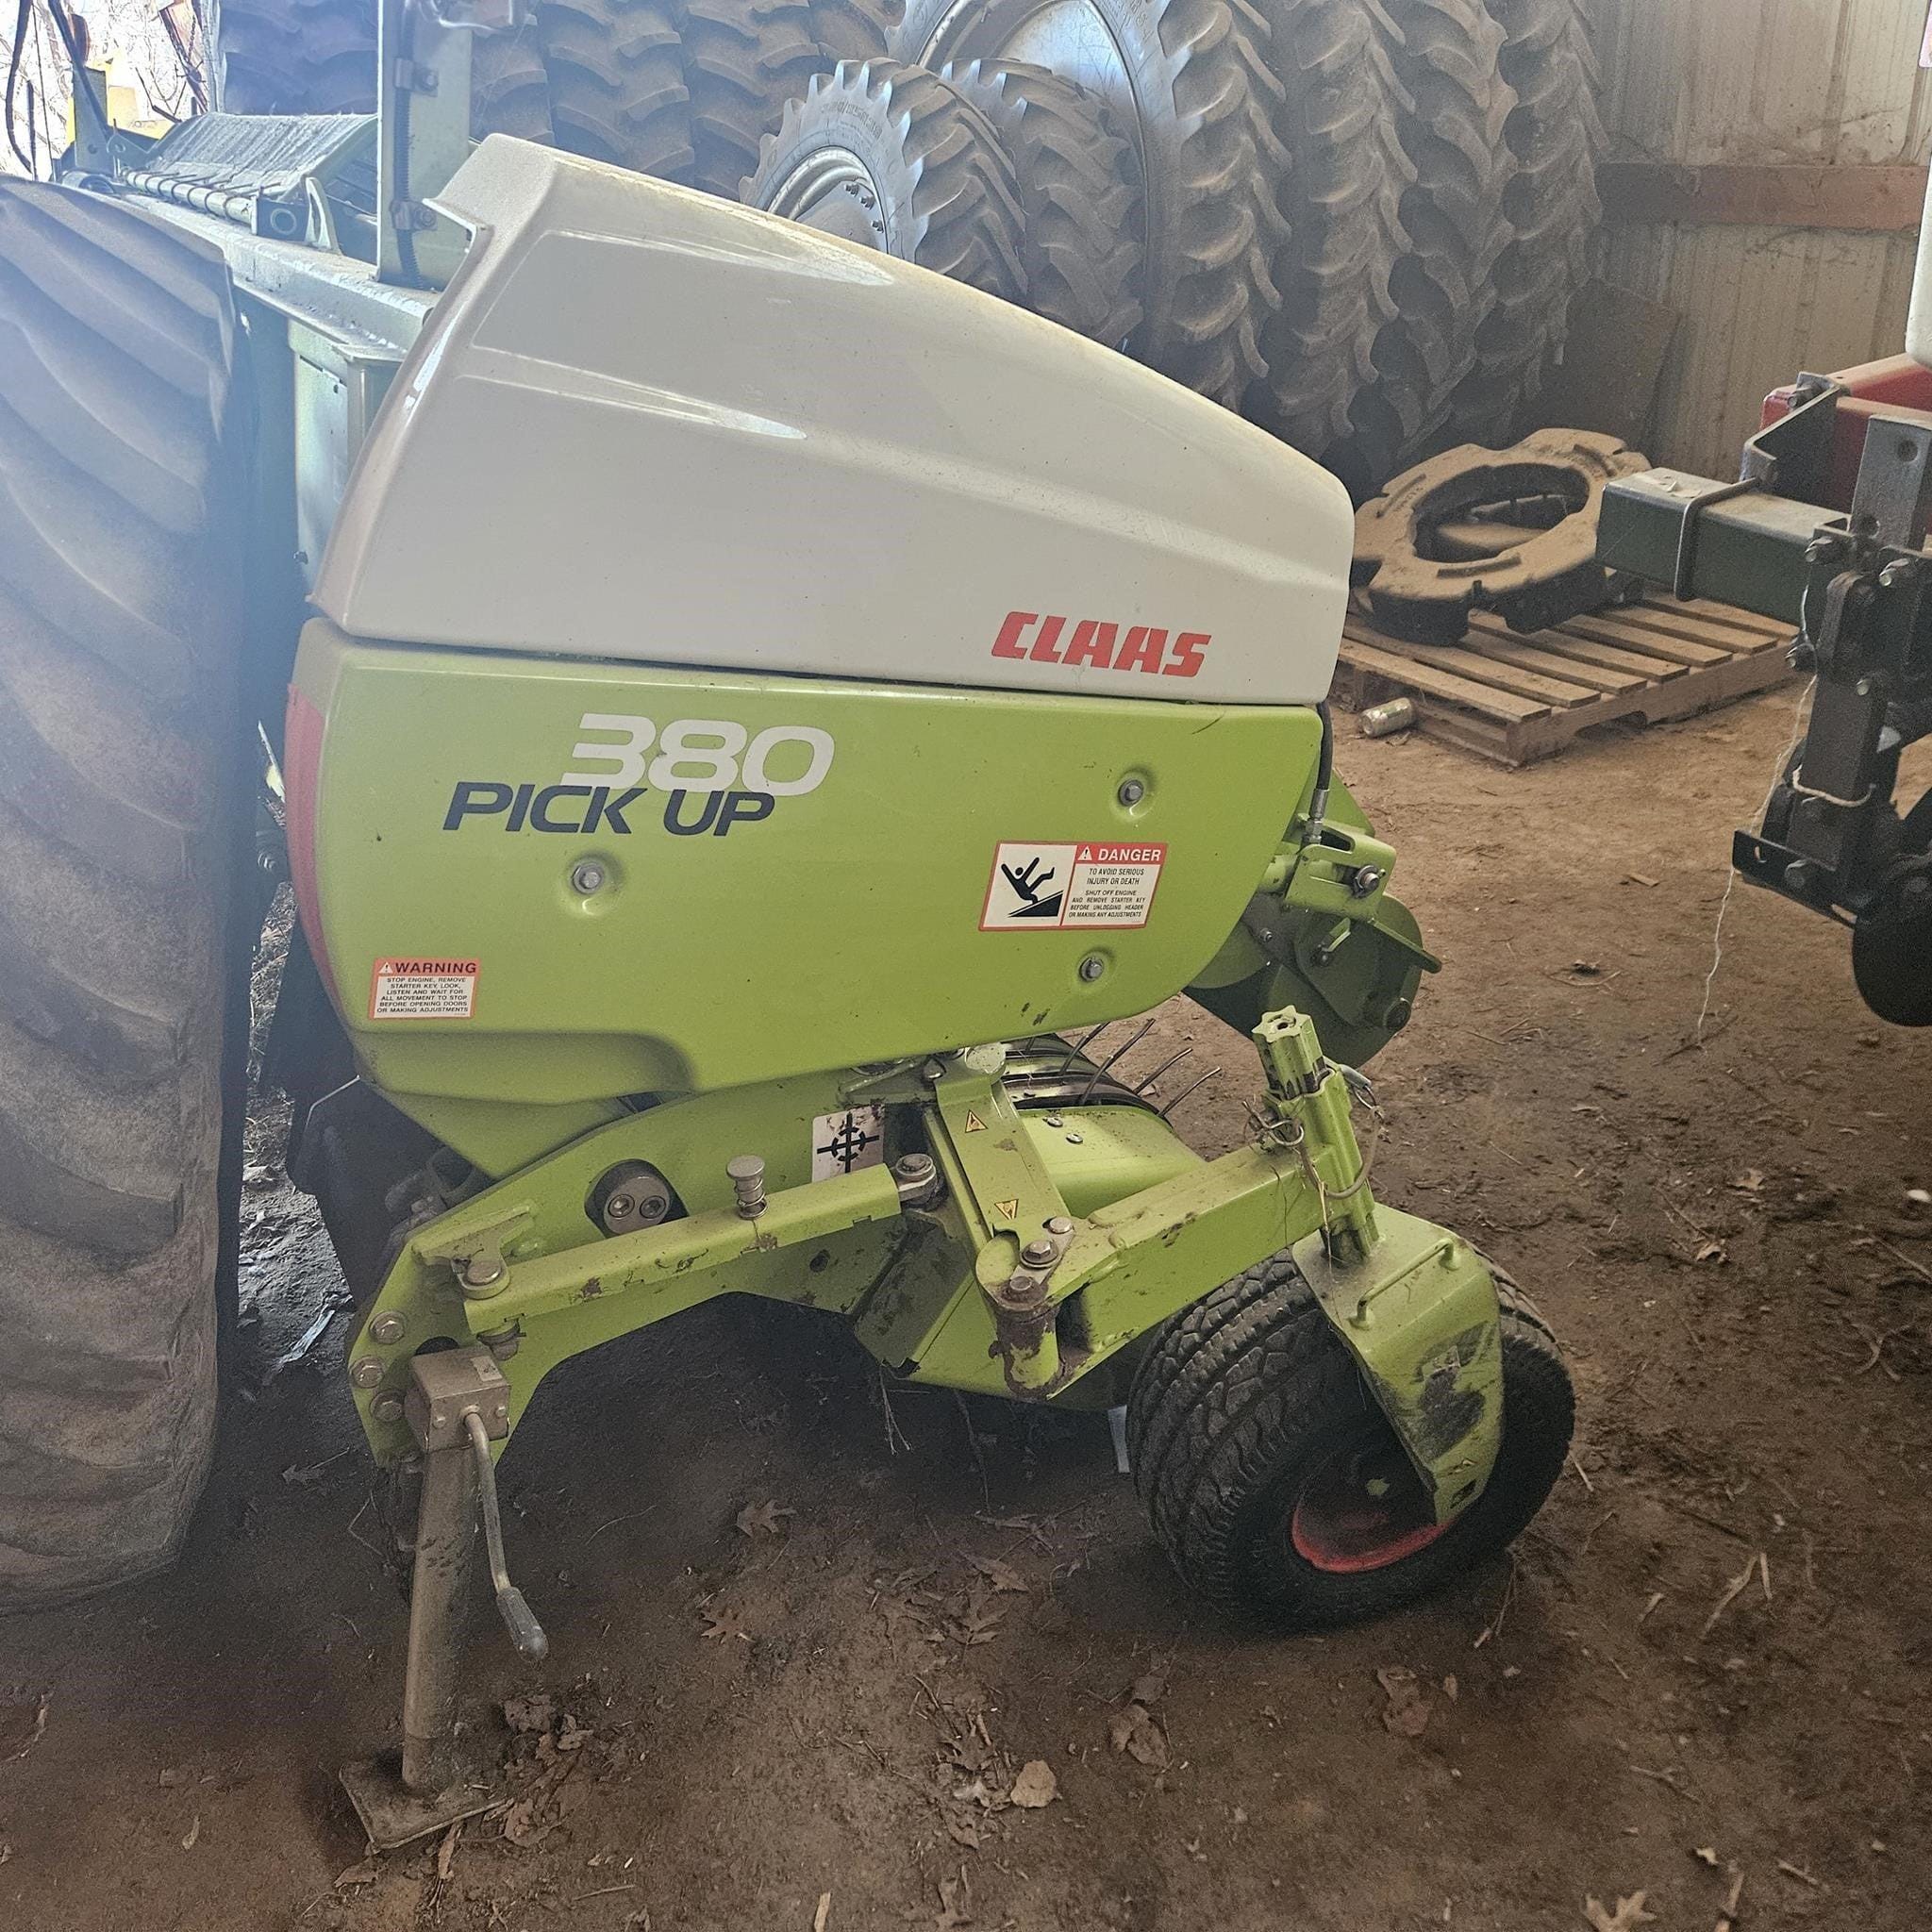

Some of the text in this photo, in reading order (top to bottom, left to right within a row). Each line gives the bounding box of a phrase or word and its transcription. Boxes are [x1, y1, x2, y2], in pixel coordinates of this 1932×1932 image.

[991, 611, 1212, 677] CLAAS
[559, 713, 836, 796] 380
[442, 781, 775, 837] PICK UP
[1097, 848, 1161, 861] DANGER
[395, 962, 476, 974] WARNING
